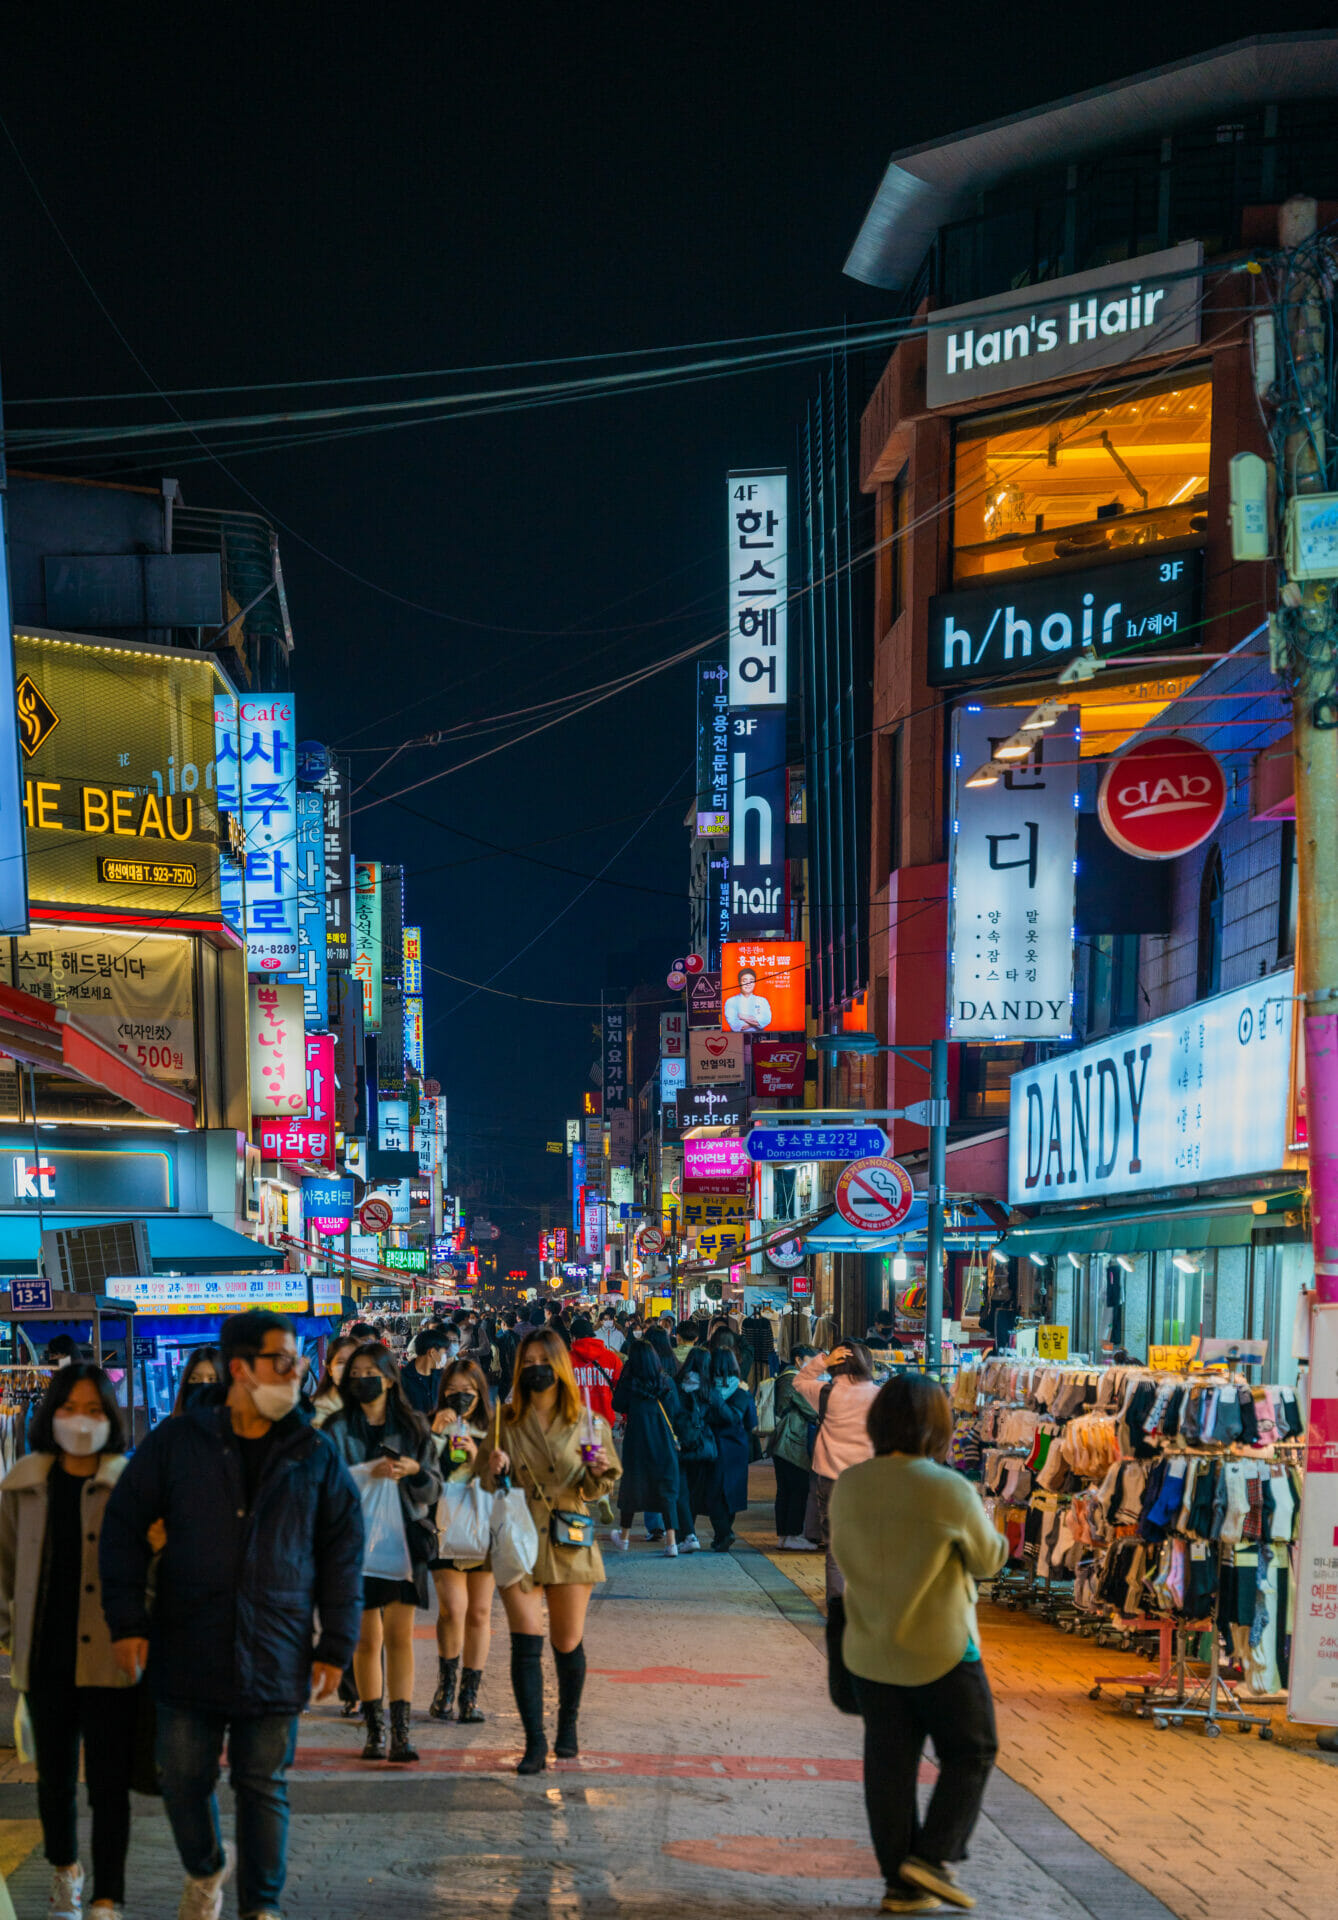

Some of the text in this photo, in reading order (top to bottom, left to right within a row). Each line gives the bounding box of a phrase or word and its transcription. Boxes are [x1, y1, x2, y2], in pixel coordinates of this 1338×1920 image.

[946, 285, 1164, 375] Han's Hair
[733, 484, 759, 501] 4F
[1159, 561, 1184, 582] 3F
[735, 508, 780, 694] 한스헤어
[943, 592, 1122, 668] h/hair
[1126, 610, 1178, 638] h/헤어
[240, 702, 291, 722] Café
[734, 719, 758, 737] 3F
[712, 695, 729, 812] 무용전문센터
[83, 786, 193, 841] BEAU
[733, 752, 773, 866] h
[714, 816, 725, 824] 3F
[153, 868, 192, 884] 923-7570
[733, 876, 783, 916] hair
[61, 952, 146, 980] 해드립니다
[264, 959, 278, 968] 3F
[958, 1000, 1065, 1021] DANDY
[666, 1016, 681, 1054] 네일
[701, 1059, 735, 1069] 헌혈의집
[769, 1053, 794, 1062] KFC
[1025, 1044, 1152, 1189] DANDY
[289, 1123, 301, 1132] 2F
[264, 1133, 328, 1157] 마라탕
[752, 1141, 763, 1149] 14
[775, 1133, 857, 1146] 동소문로22길
[868, 1139, 880, 1148] 18
[687, 1153, 727, 1164] 아이러브
[766, 1148, 866, 1158] Dongsomun-ro 22-gil
[13, 1156, 56, 1197] kt
[685, 1205, 745, 1225] 부동산
[16, 1290, 47, 1303] 13-1
